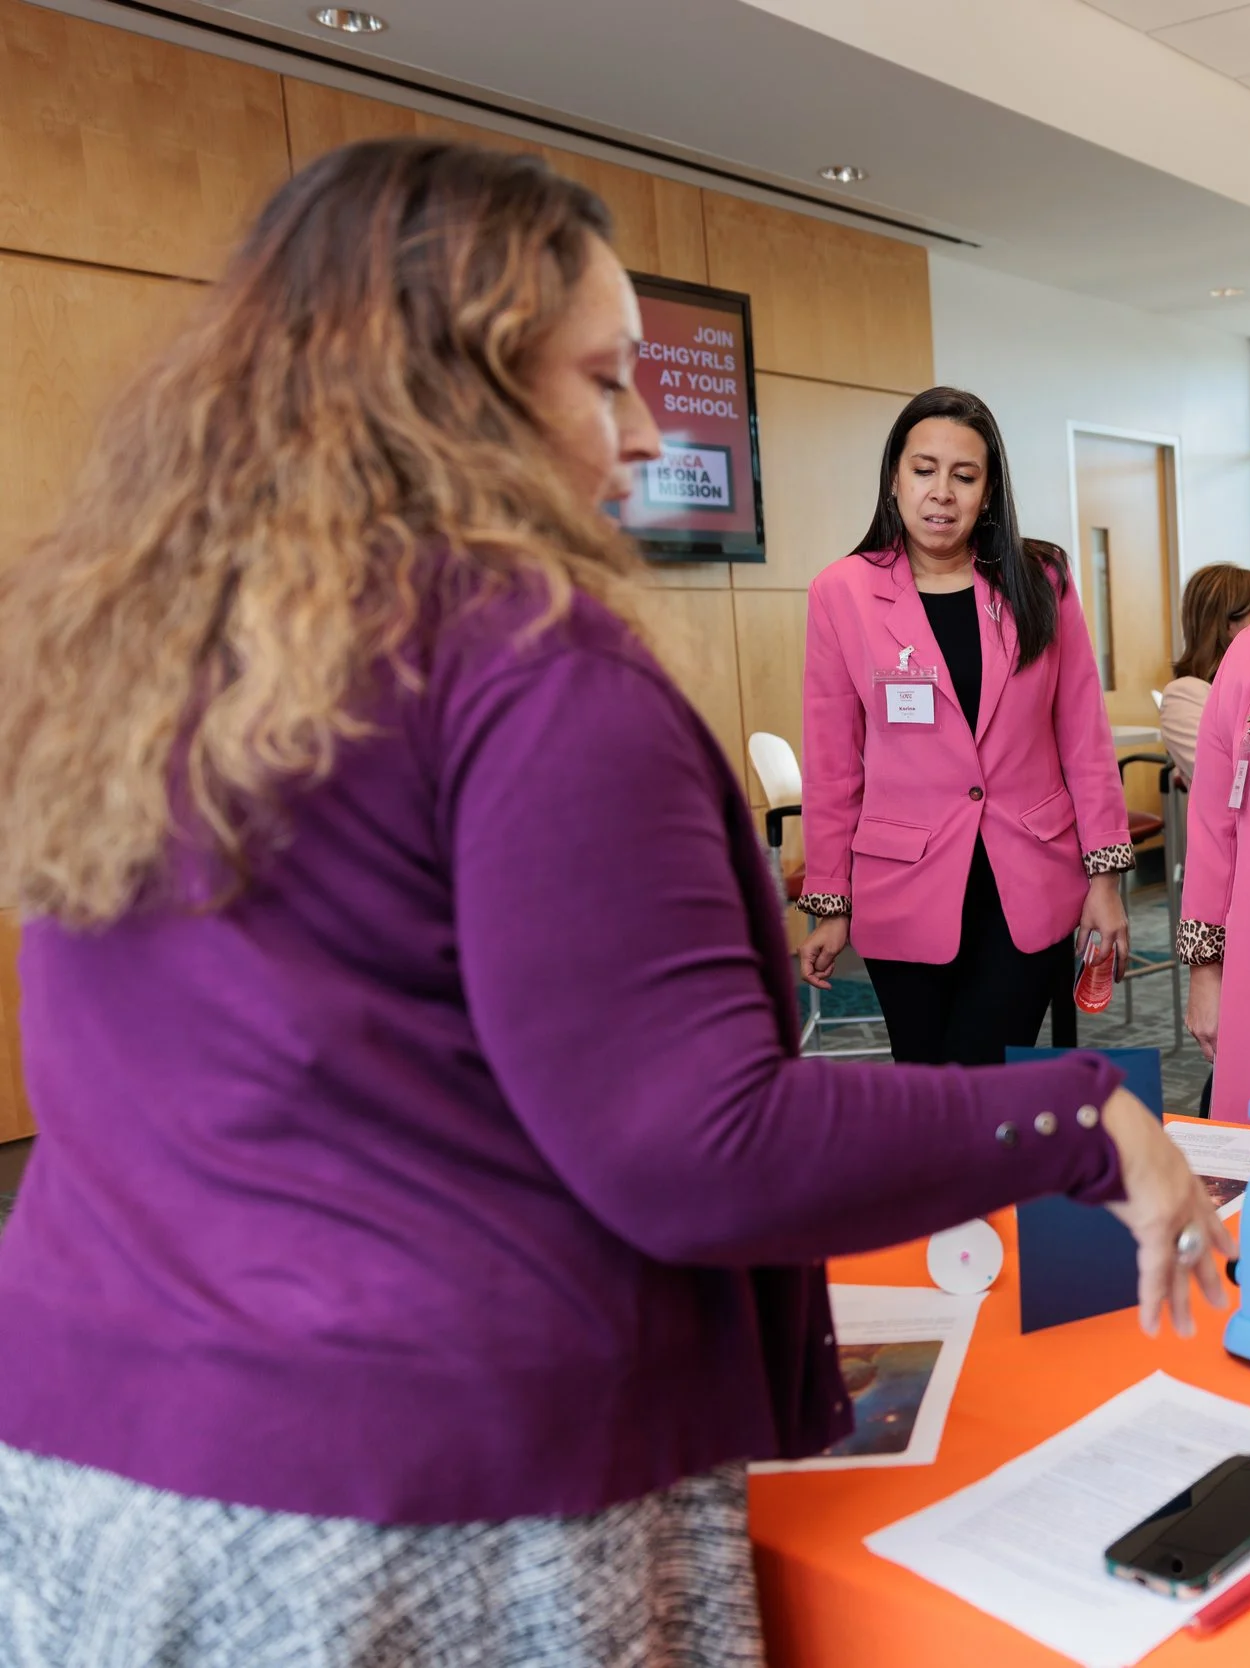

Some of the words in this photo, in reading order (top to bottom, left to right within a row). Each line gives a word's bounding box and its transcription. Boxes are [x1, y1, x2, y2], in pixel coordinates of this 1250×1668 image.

[694, 327, 733, 348] JOIN
[639, 340, 735, 371] ECHGYRLS
[660, 369, 682, 387] AT
[686, 371, 737, 394] YOUR
[663, 393, 739, 419] SCHOOL
[657, 466, 671, 480] IS
[675, 469, 697, 482] ON
[701, 470, 711, 484] A
[658, 482, 722, 498] MISSION
